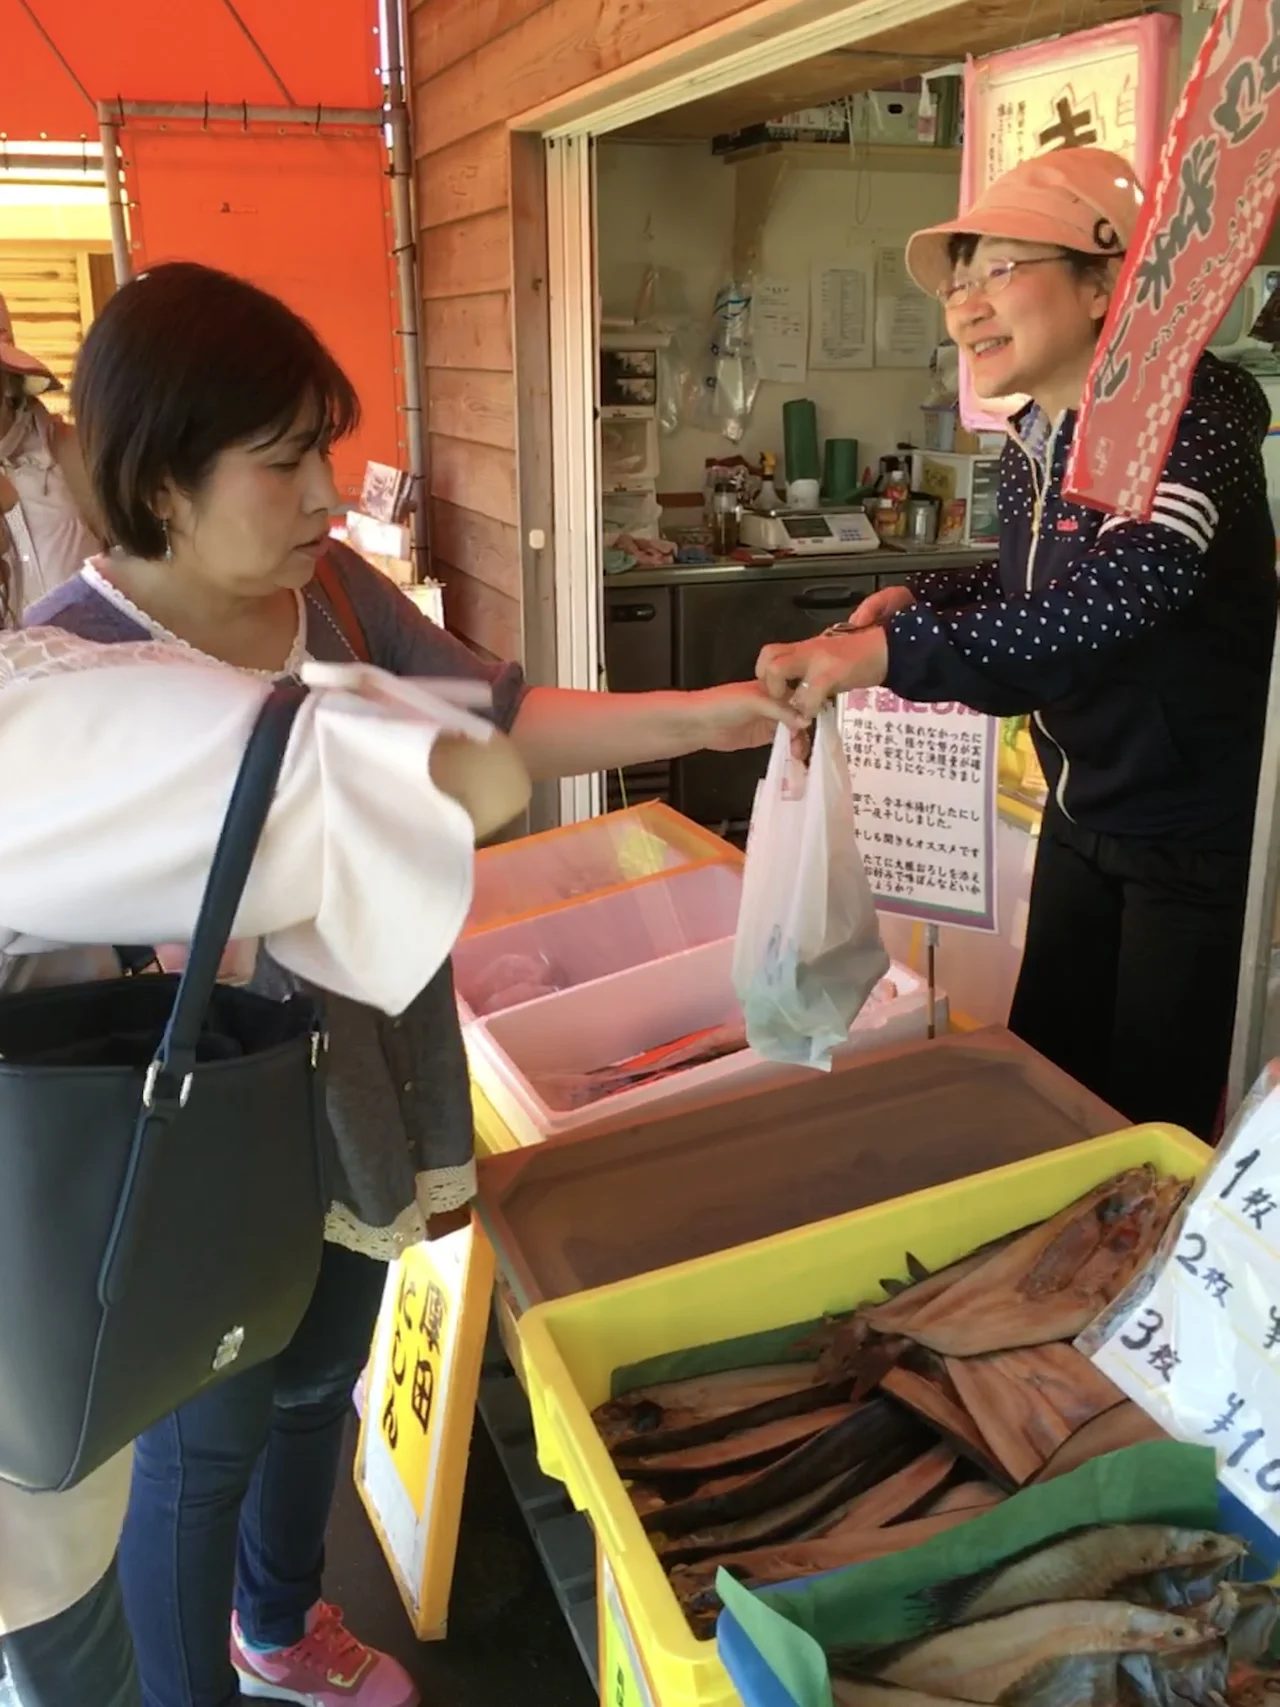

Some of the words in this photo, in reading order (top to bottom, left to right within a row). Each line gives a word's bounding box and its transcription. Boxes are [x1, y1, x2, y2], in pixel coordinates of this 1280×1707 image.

[1219, 1148, 1277, 1231] 1枚
[1176, 1232, 1234, 1309] 2枚
[1120, 1308, 1183, 1384] 3枚
